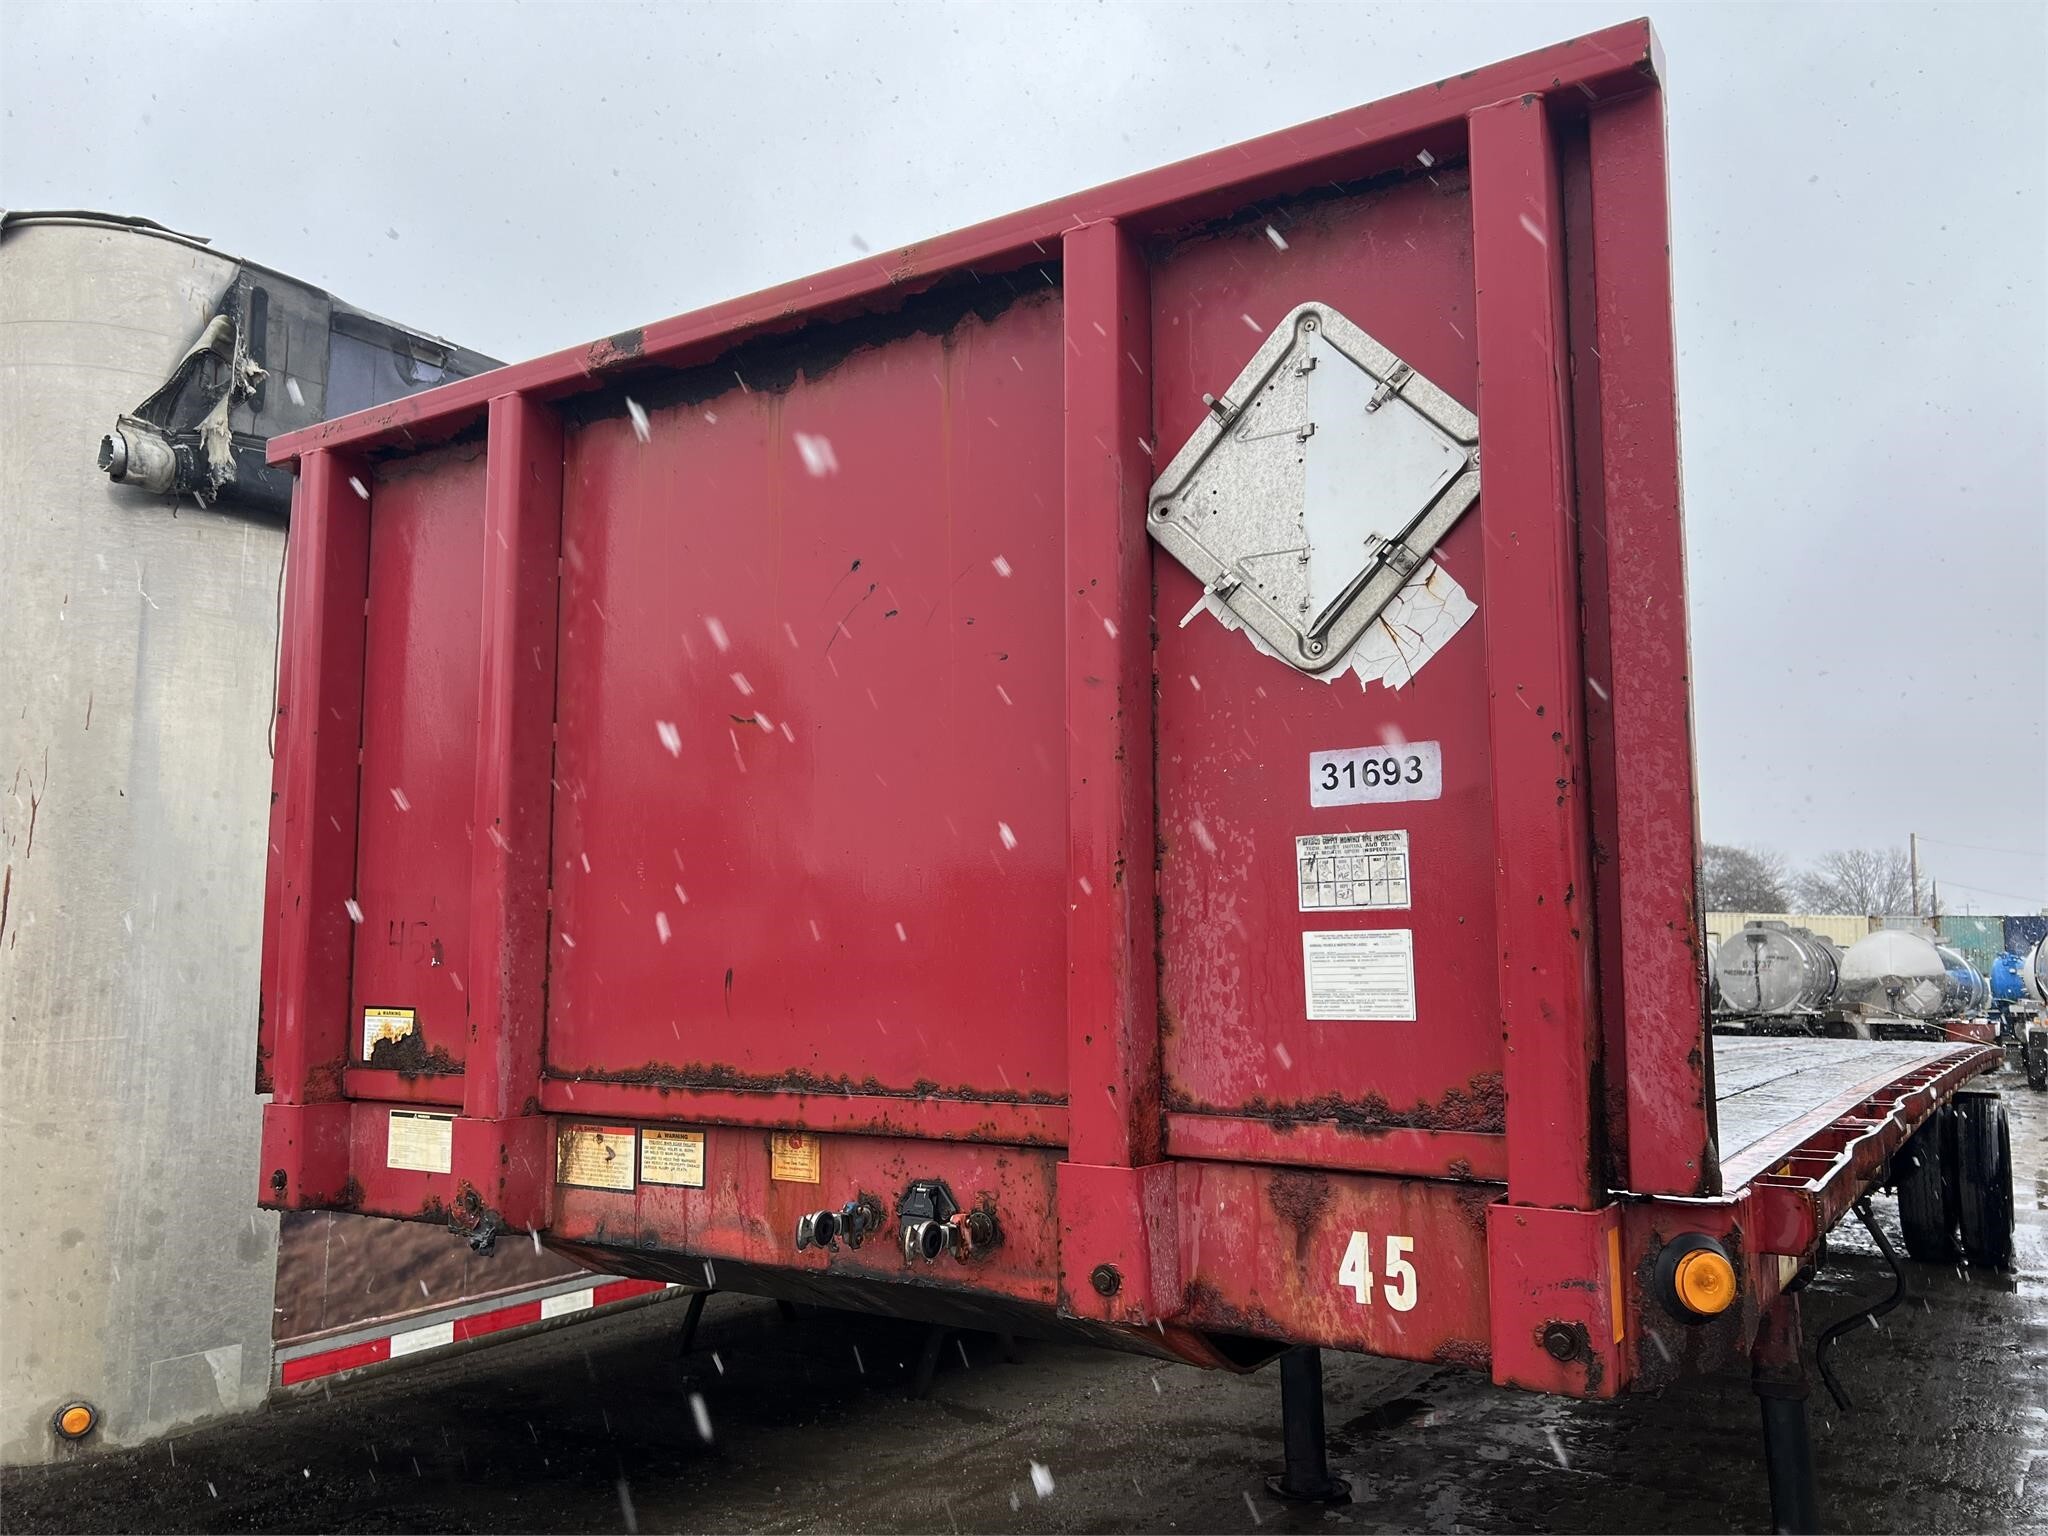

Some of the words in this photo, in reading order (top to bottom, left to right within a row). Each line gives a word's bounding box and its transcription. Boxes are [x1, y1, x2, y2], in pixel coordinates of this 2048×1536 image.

[1321, 755, 1423, 791] 31693
[664, 1132, 689, 1140] WARNING
[1338, 1230, 1418, 1312] 45
